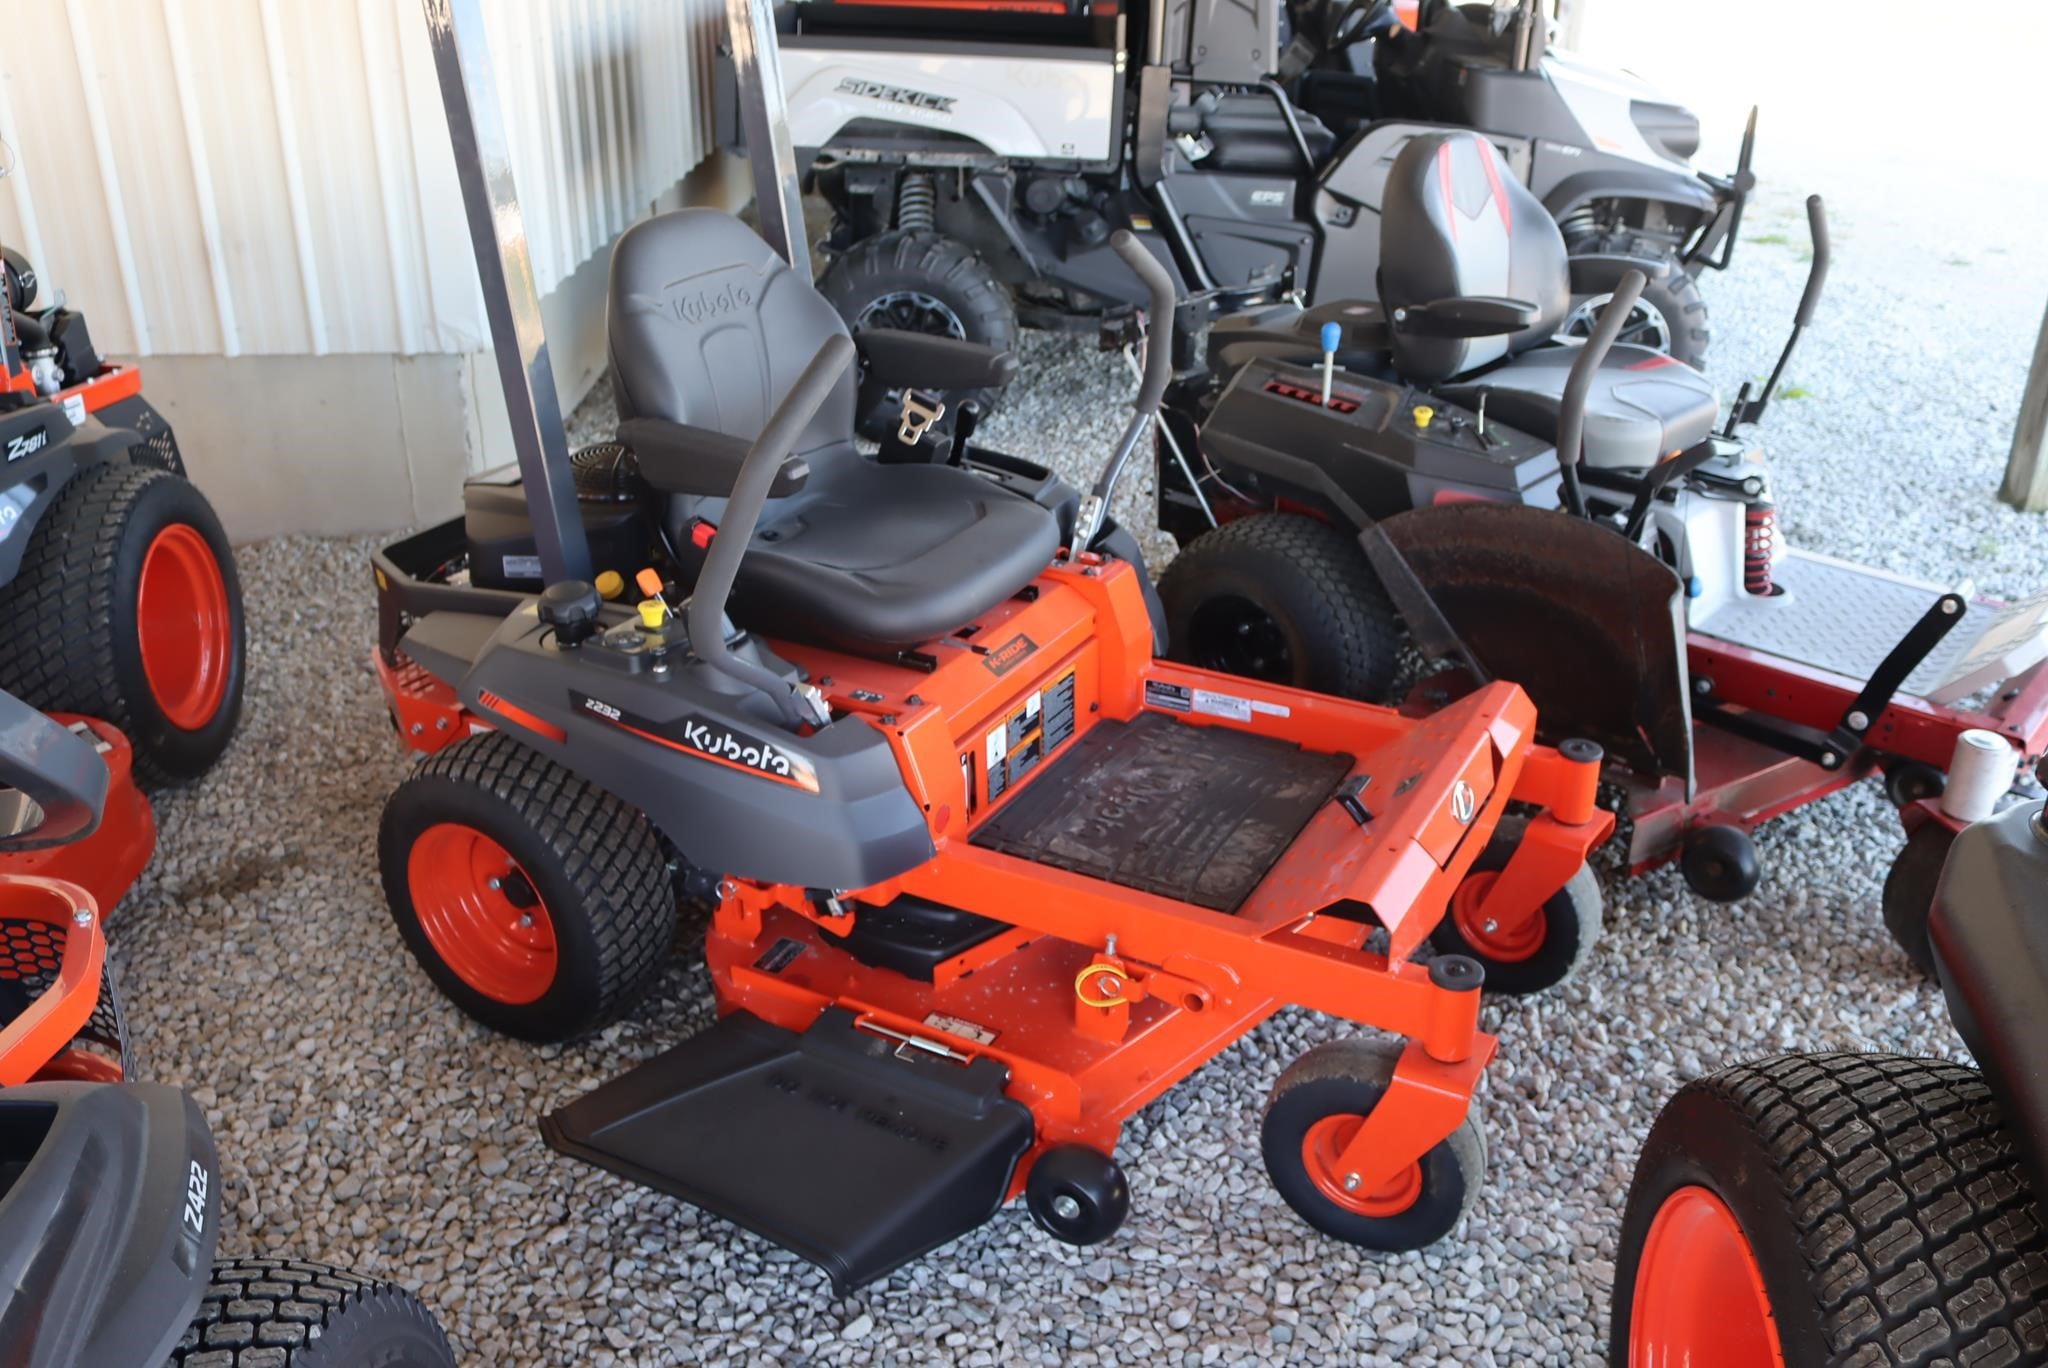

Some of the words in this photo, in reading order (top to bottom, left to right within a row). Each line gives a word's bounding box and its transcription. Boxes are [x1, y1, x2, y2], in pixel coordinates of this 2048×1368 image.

[834, 77, 958, 114] SIDEKICK
[672, 283, 751, 325] Kubota
[584, 698, 621, 721] Z232
[683, 720, 791, 776] Kubota
[183, 1160, 208, 1233] Z422
